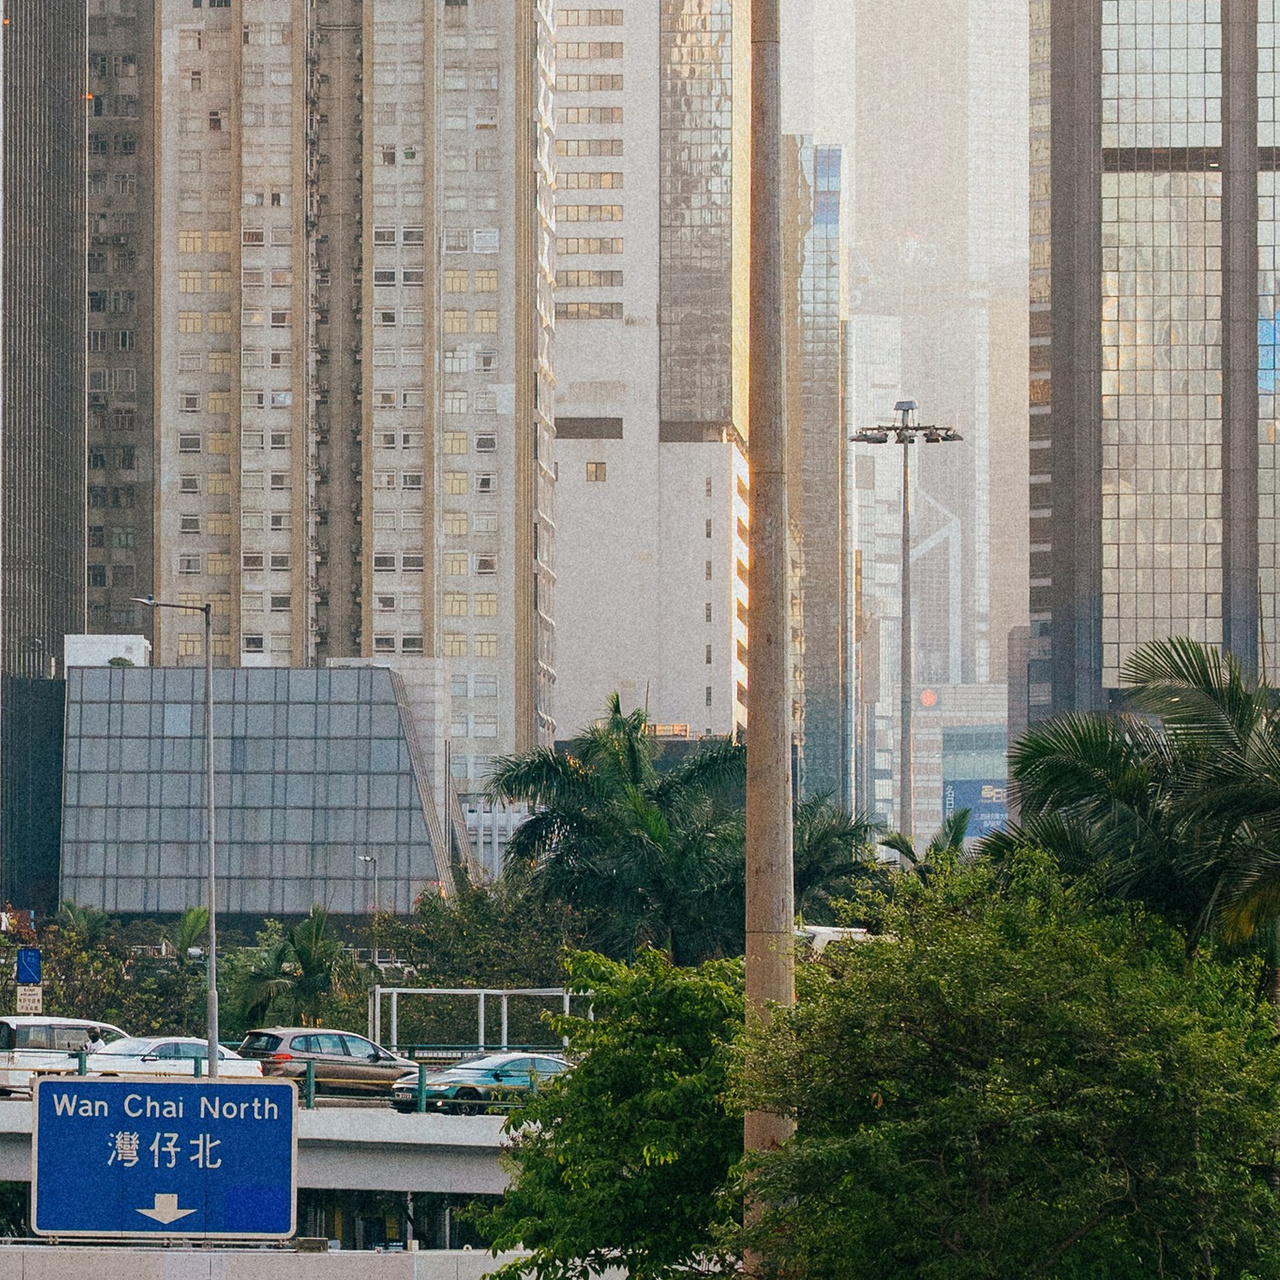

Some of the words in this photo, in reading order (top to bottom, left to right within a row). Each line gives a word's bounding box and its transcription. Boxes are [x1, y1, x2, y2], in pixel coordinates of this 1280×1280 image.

[53, 1093, 109, 1117] Wan
[123, 1093, 183, 1118] Chai
[200, 1096, 279, 1120] North
[107, 1131, 222, 1169] 灣仔北
